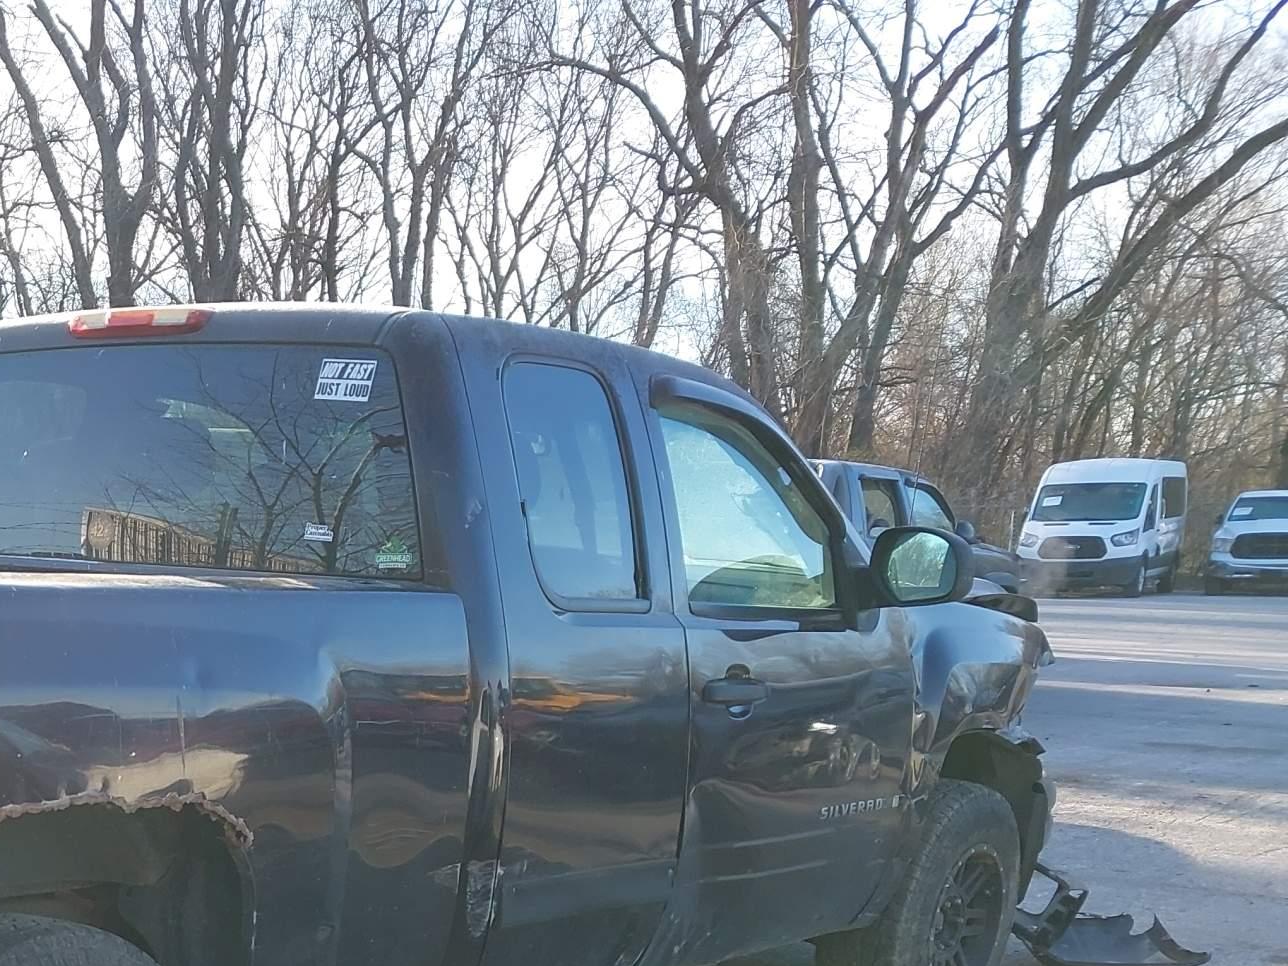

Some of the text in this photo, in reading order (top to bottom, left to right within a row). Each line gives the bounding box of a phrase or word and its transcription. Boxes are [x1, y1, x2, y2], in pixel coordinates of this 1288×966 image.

[321, 362, 375, 380] NOT FAST
[316, 382, 370, 398] JUST LOUD
